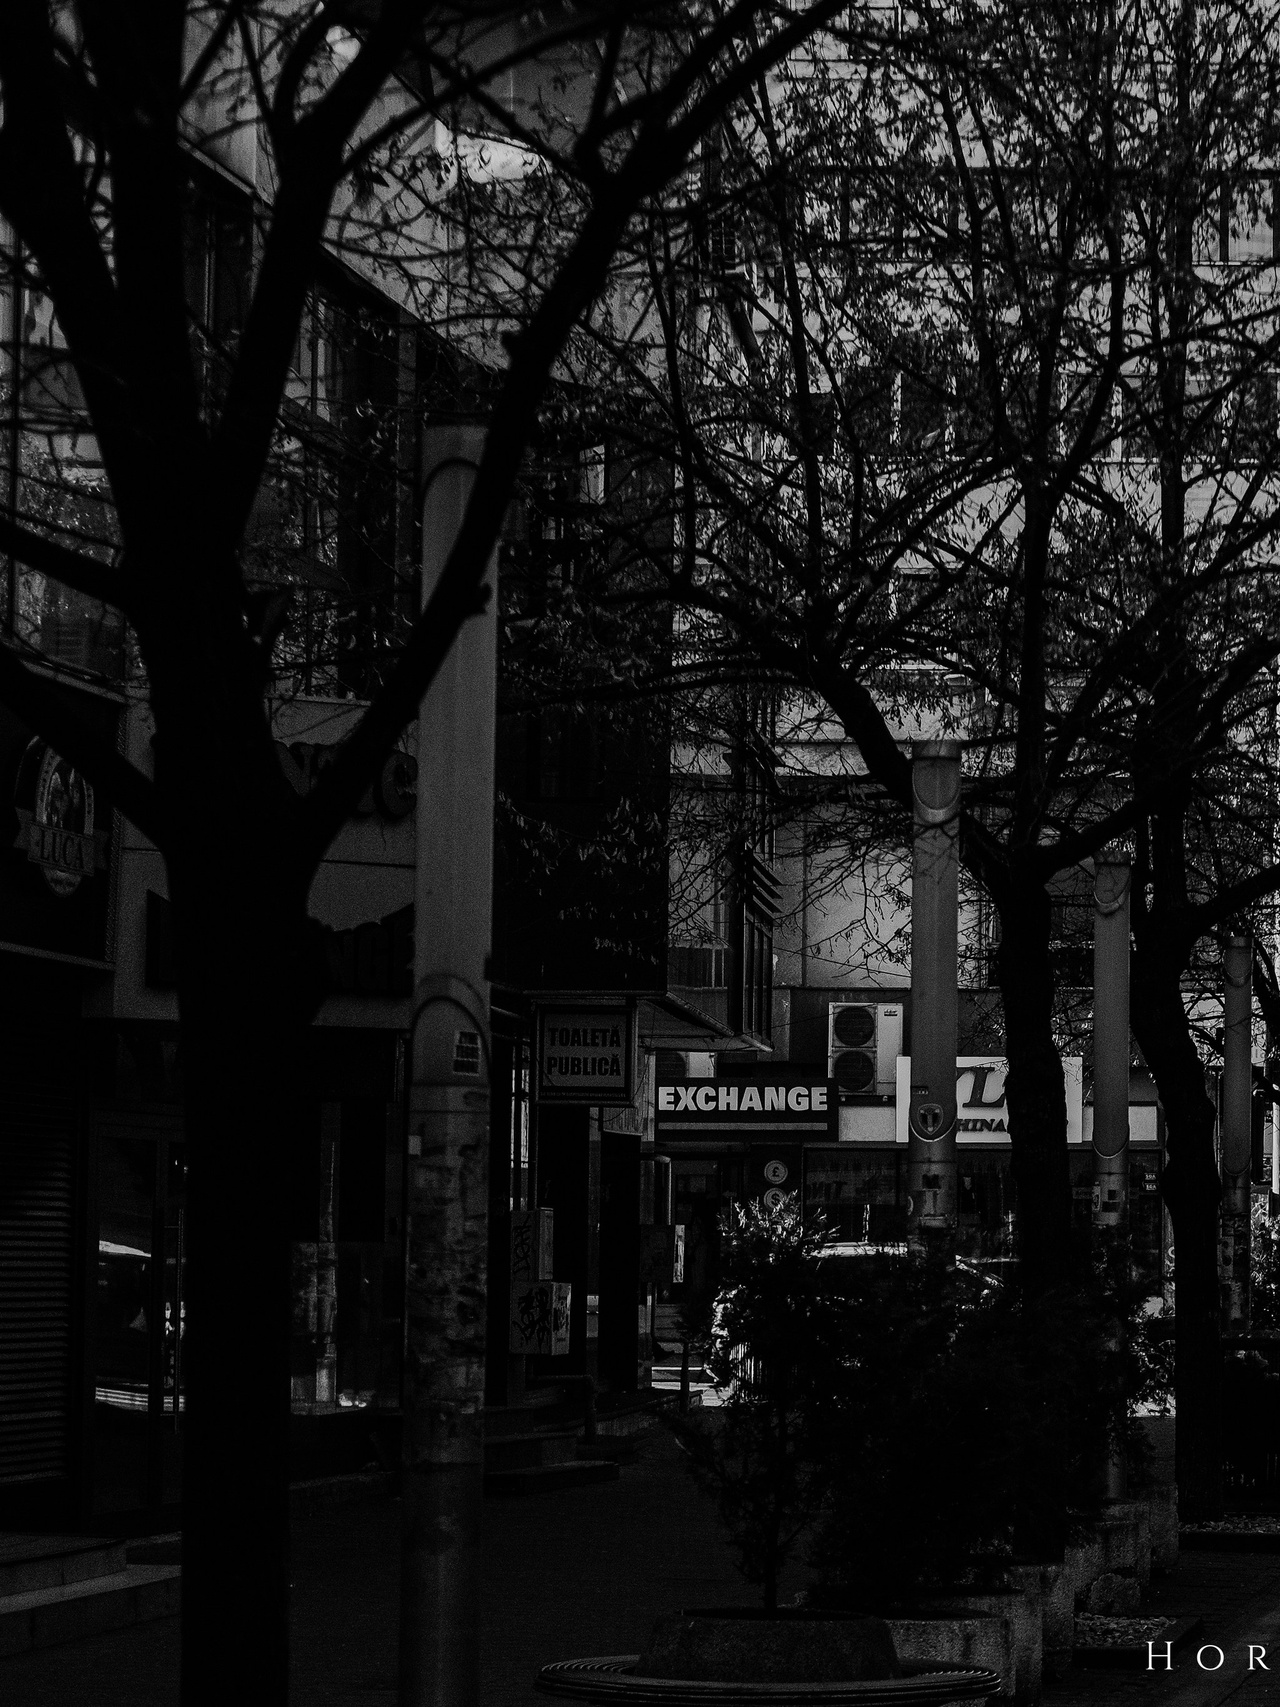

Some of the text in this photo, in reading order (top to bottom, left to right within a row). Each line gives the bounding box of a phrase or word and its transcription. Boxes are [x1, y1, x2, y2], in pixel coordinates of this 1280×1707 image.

[39, 829, 85, 870] LUCA
[548, 1025, 621, 1047] TOALETĂ
[547, 1053, 621, 1076] PUBLICĂ
[658, 1086, 828, 1111] EXCHANGE
[956, 1118, 1007, 1132] HINA
